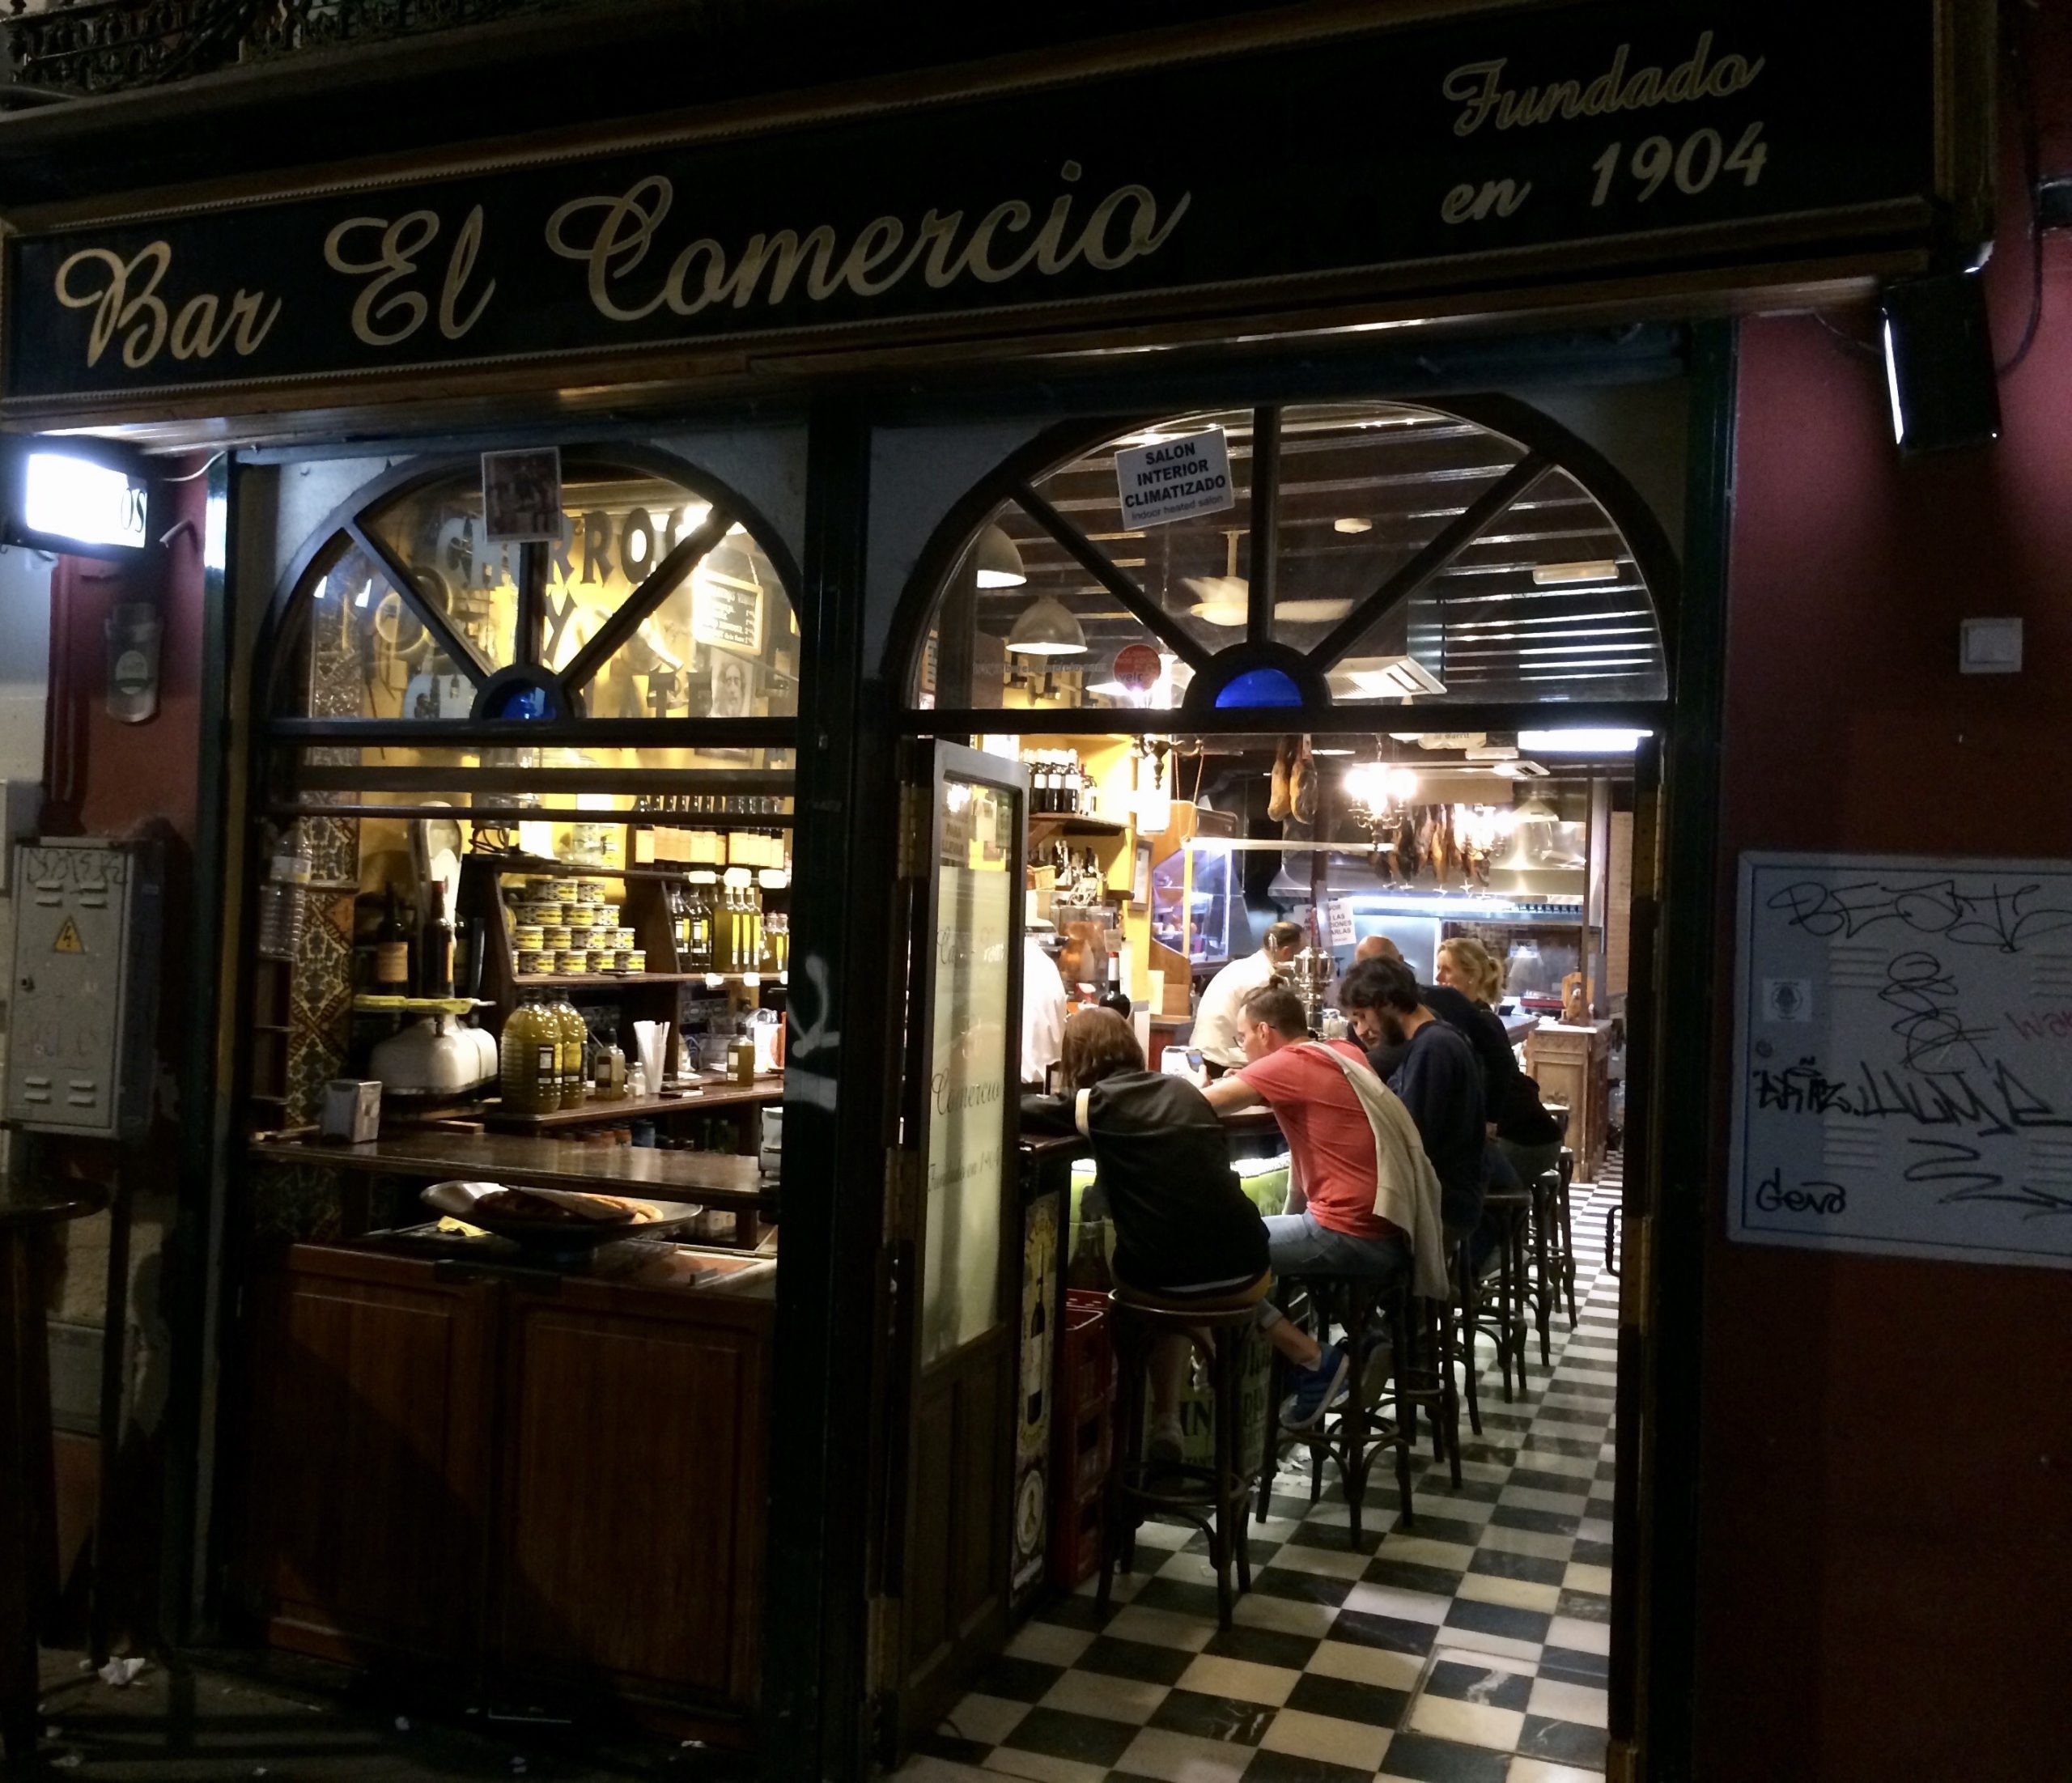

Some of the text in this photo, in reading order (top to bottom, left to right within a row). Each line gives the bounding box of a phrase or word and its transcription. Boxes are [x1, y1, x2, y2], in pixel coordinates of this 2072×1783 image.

[1442, 30, 1765, 137] Fundado
[1441, 121, 1768, 225] en 1904
[54, 159, 1191, 369] Bar El Comercio
[1136, 459, 1209, 486] INTERIOR
[1145, 442, 1196, 465] SALON
[1124, 474, 1226, 508] CLIMATIZADO
